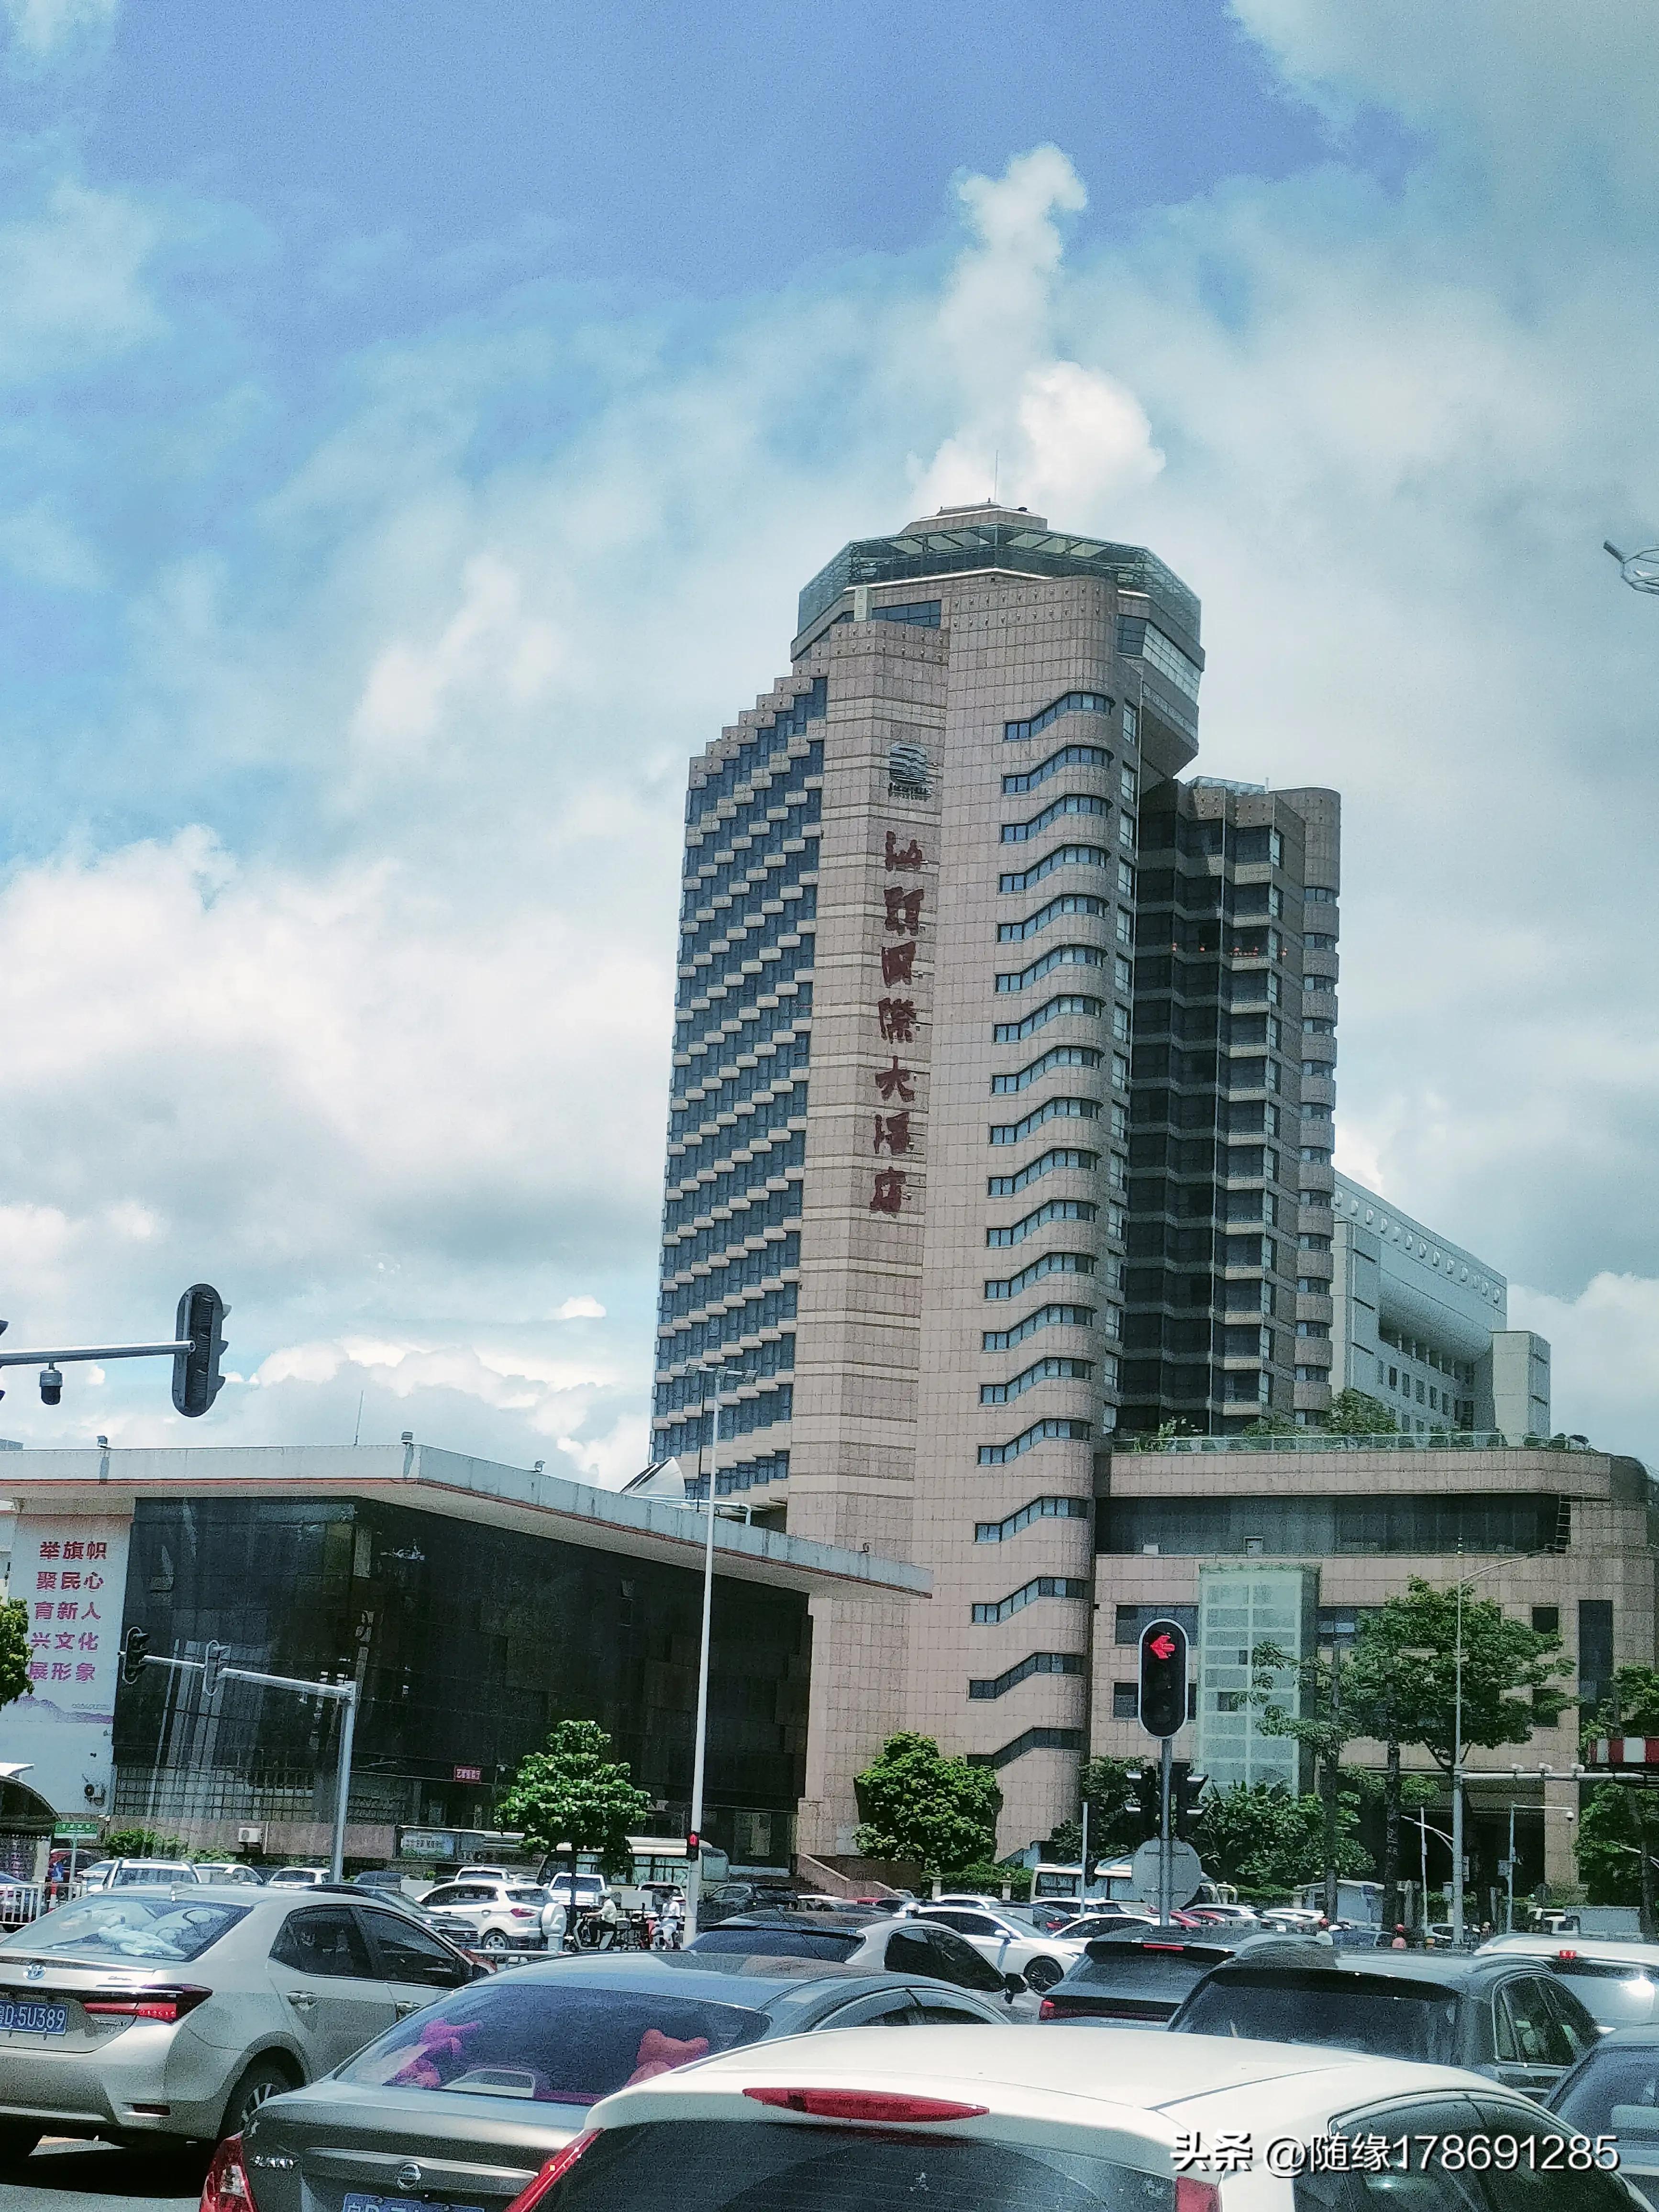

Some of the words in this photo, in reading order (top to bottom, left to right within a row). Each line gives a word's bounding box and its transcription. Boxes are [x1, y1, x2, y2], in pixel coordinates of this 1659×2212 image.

[39, 1541, 108, 1560] 举旗帜
[35, 1571, 104, 1590] 聚民心
[34, 1601, 101, 1620] 育新人
[30, 1631, 99, 1650] 兴文化
[28, 1662, 96, 1681] 展形象
